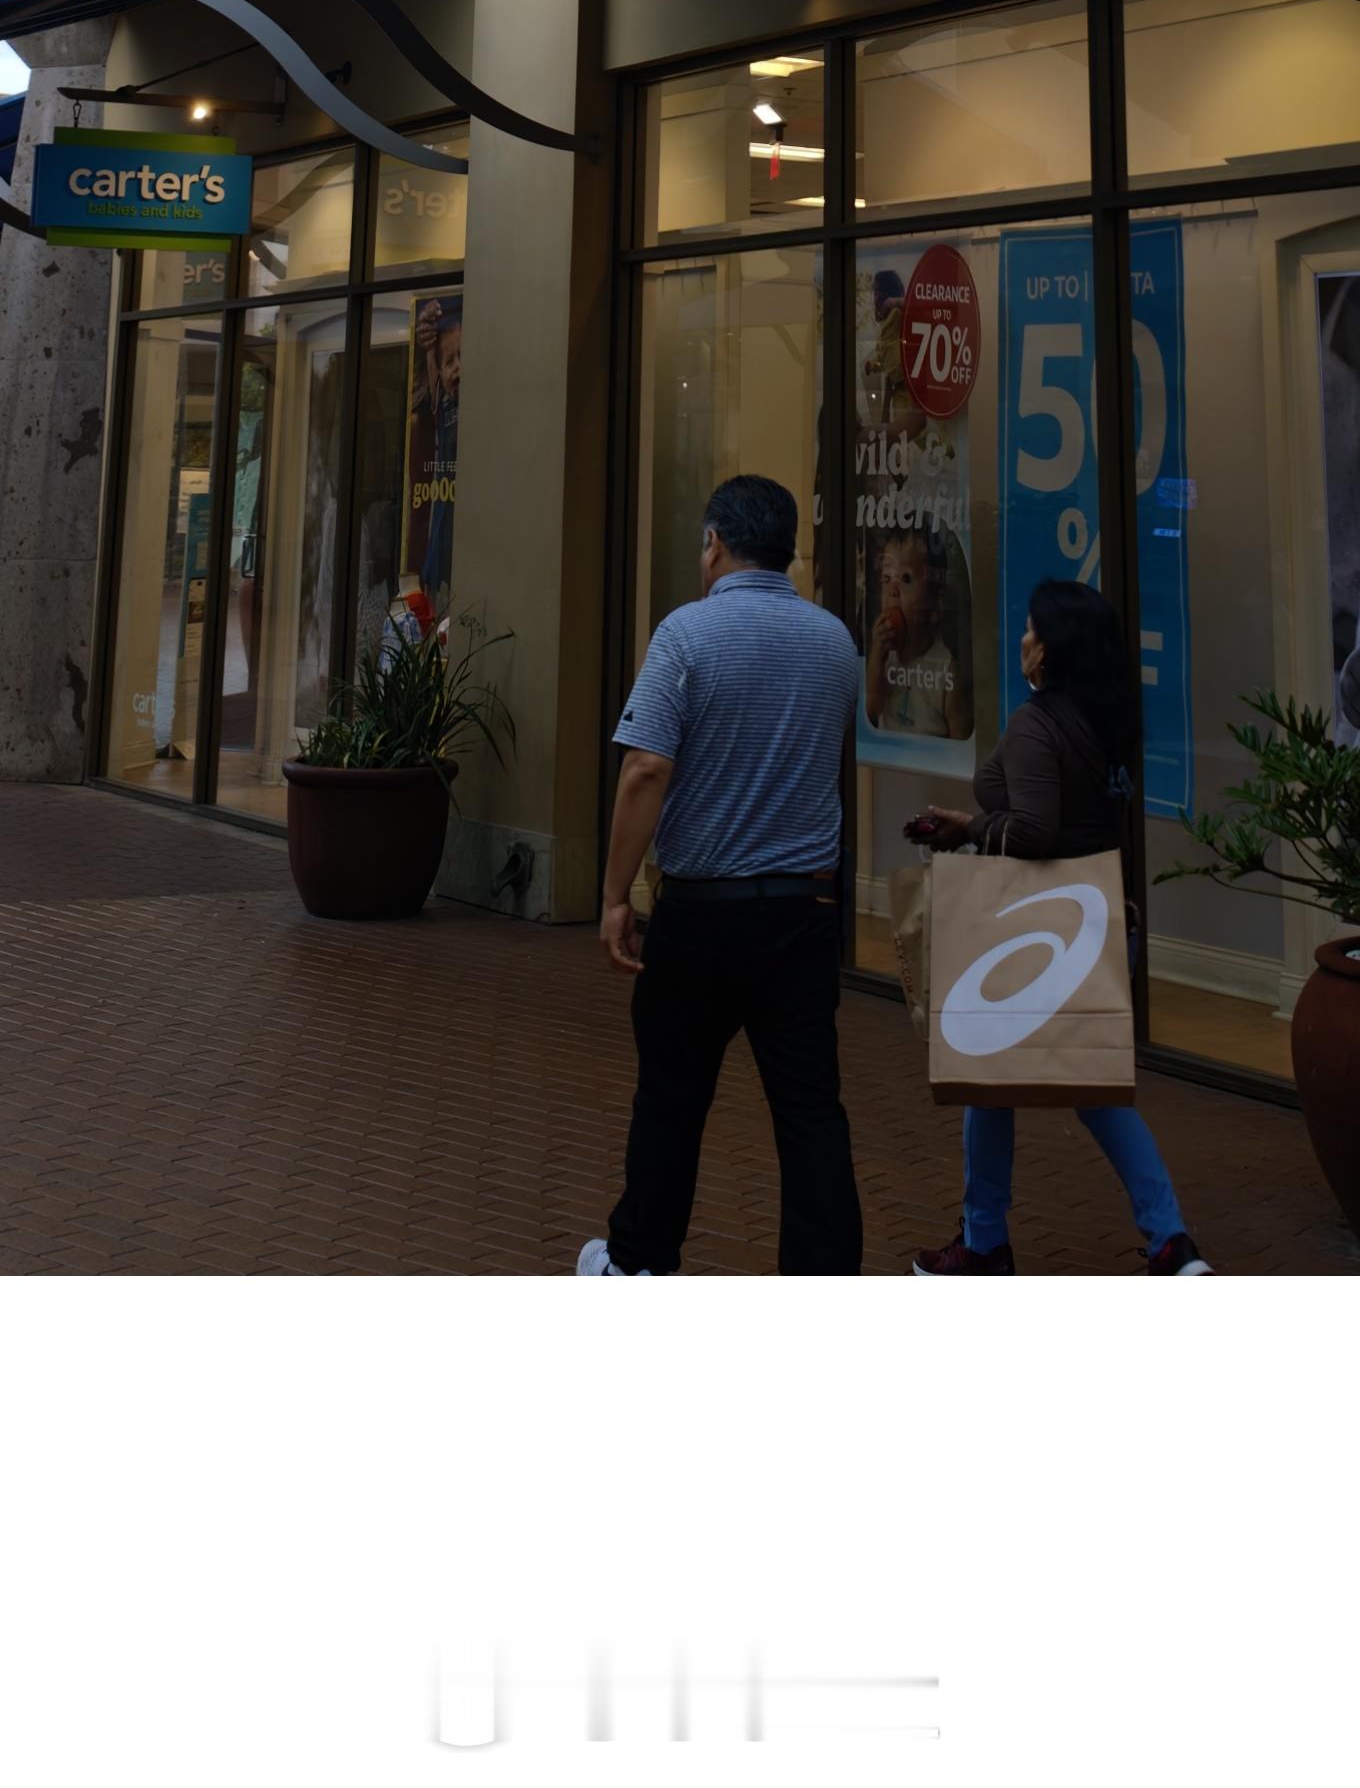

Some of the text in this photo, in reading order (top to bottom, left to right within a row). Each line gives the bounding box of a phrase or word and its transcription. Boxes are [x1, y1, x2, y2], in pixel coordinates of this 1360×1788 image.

[68, 164, 226, 204] carter's
[87, 201, 203, 220] babies and kids
[914, 283, 971, 304] CLEARANCE
[1026, 275, 1080, 299] UP TO
[932, 308, 952, 321] UP TO
[950, 367, 972, 385] OFF
[423, 461, 446, 473] LITTLE
[886, 663, 955, 693] carter's
